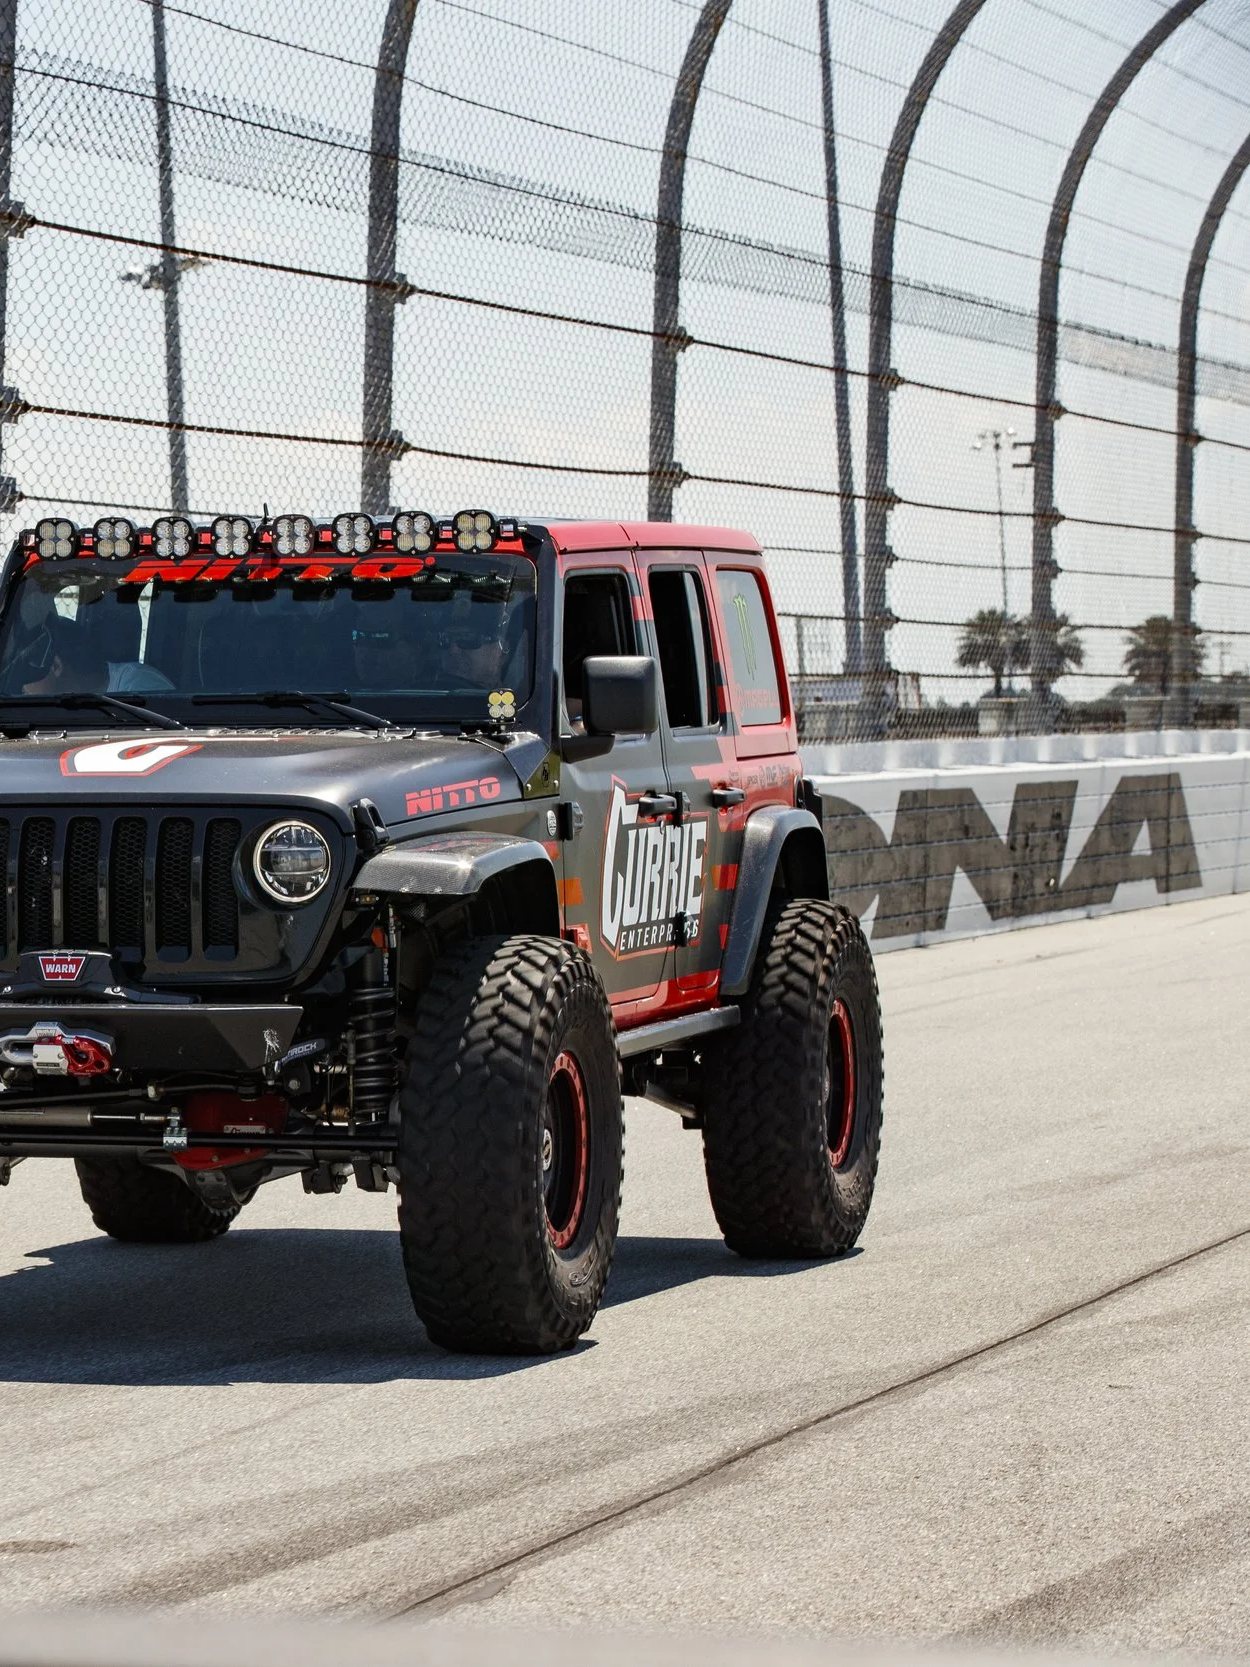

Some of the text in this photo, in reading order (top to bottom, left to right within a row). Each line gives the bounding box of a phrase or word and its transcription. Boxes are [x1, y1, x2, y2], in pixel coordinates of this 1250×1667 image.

[123, 557, 429, 581] NITTO
[405, 777, 501, 816] NITTO
[602, 785, 707, 946] CURRIE
[45, 964, 76, 973] WARN
